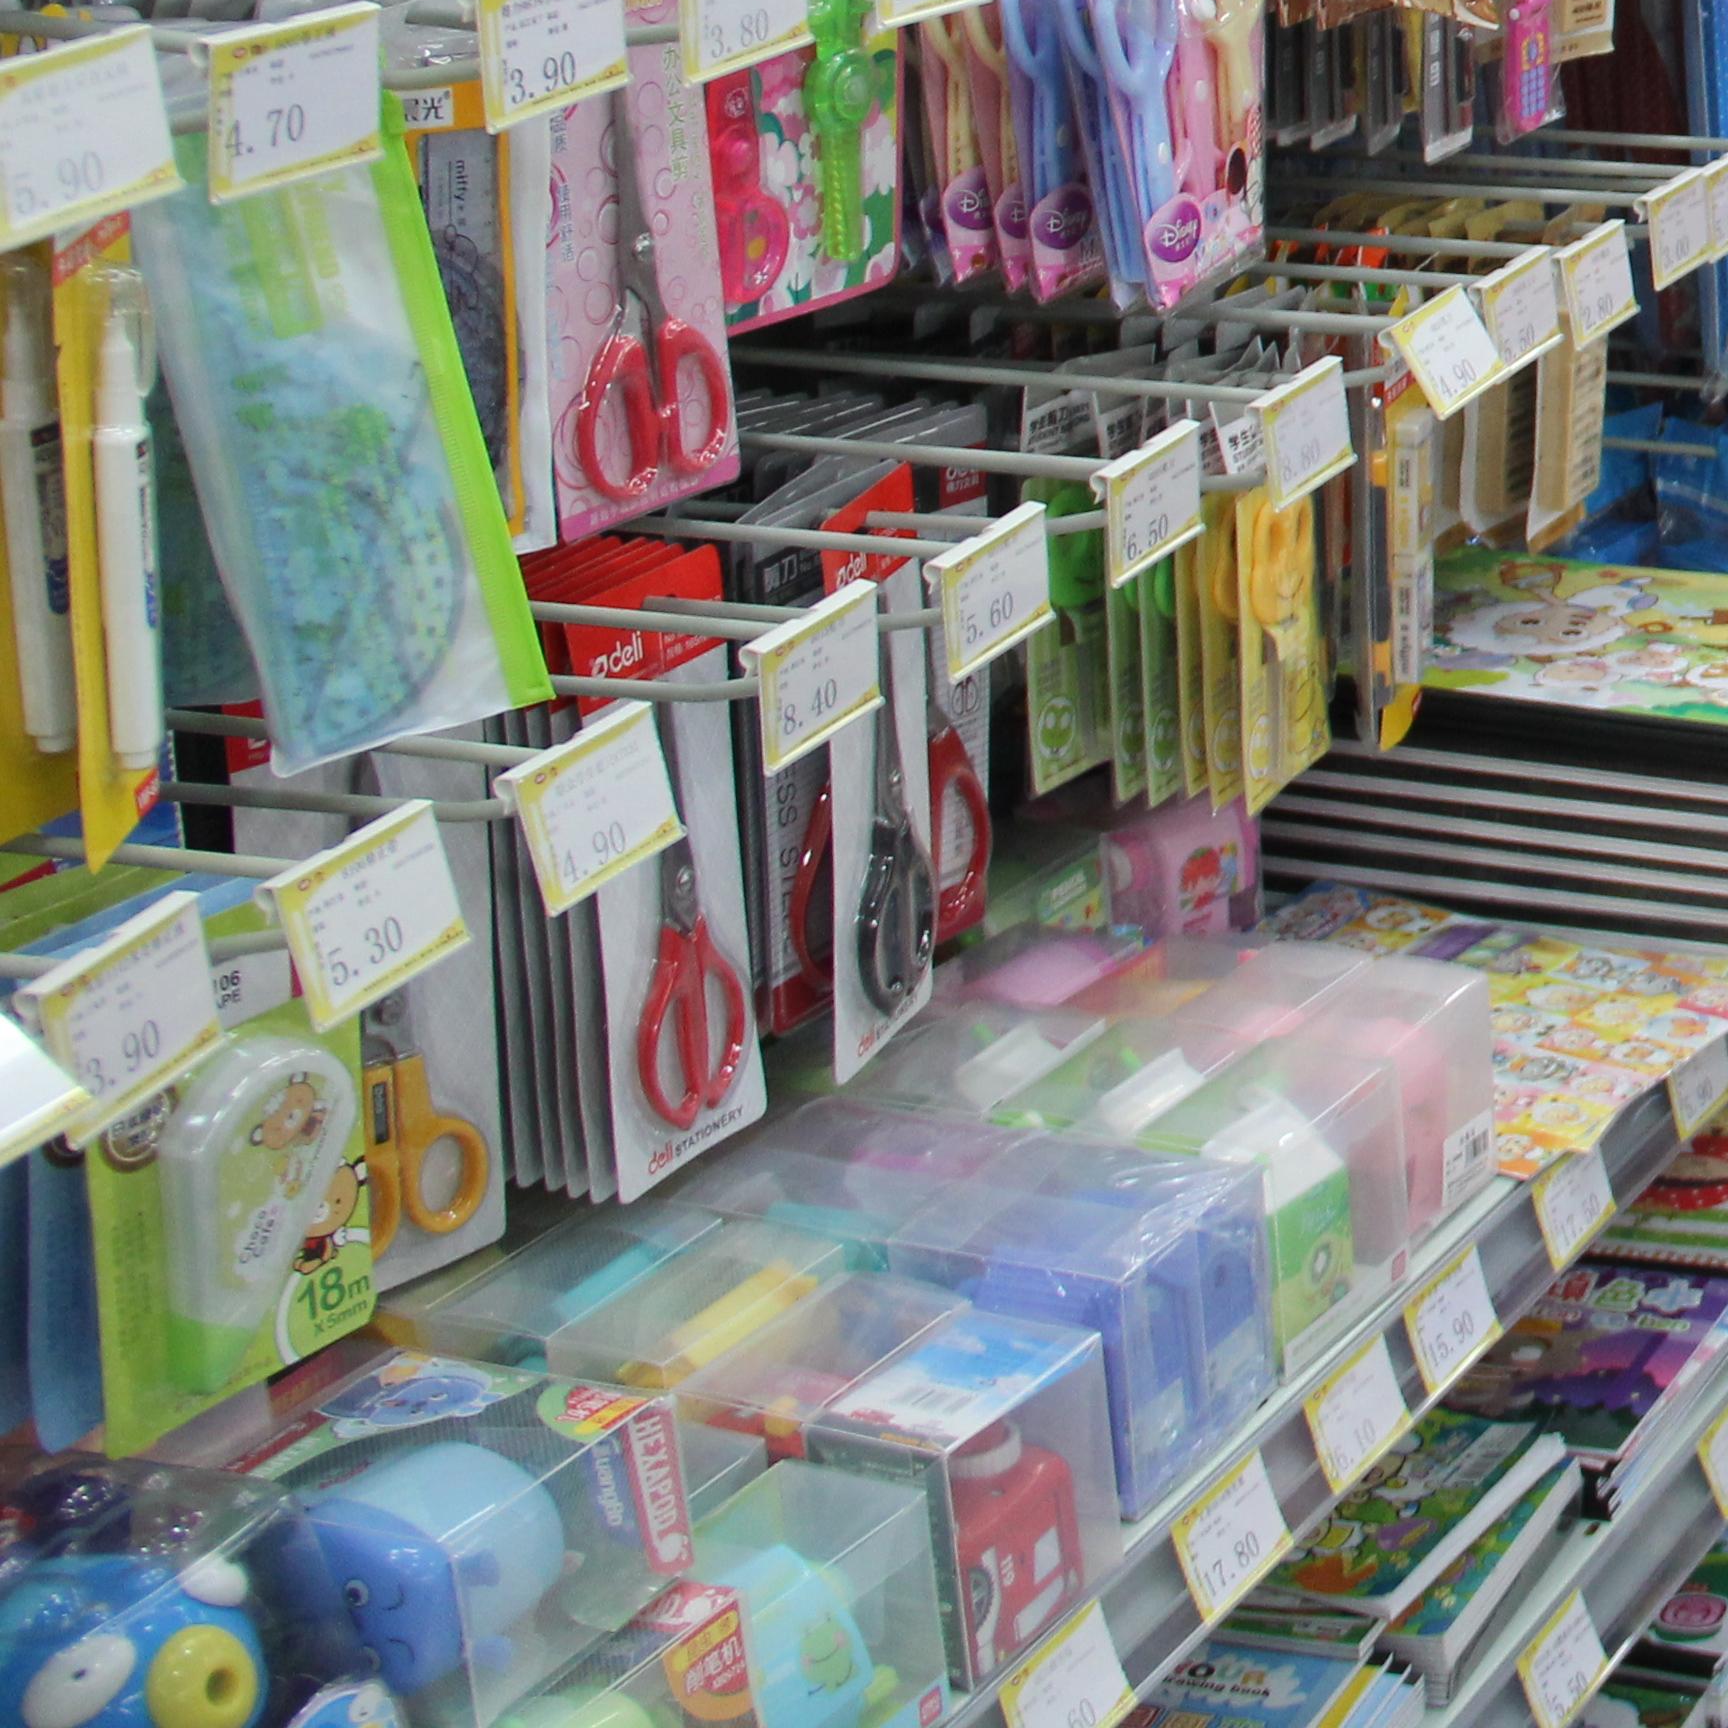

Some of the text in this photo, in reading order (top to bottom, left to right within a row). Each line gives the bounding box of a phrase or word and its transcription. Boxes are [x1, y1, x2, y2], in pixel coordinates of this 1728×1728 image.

[710, 8, 769, 59] 3.80
[509, 51, 577, 105] 3.90
[225, 103, 305, 158] 4.70
[663, 47, 689, 182] 办公文具剪
[14, 150, 105, 216] 5.90
[455, 159, 469, 203] miffy
[1159, 215, 1198, 247] Disney
[1440, 358, 1477, 400] 4.90
[1126, 513, 1169, 562] 6.50
[846, 552, 867, 582] deli
[966, 591, 1014, 645] 5.60
[609, 629, 643, 674] deli
[783, 678, 838, 736] 8.40
[562, 821, 626, 884] 4.90
[331, 916, 404, 989] 5.30
[87, 1018, 160, 1099] 3.90
[647, 1104, 745, 1175] deli STATIONERY
[1429, 1309, 1475, 1368] 15.90
[633, 1414, 679, 1535] HEXAPOD
[1203, 1530, 1261, 1599] 17.80
